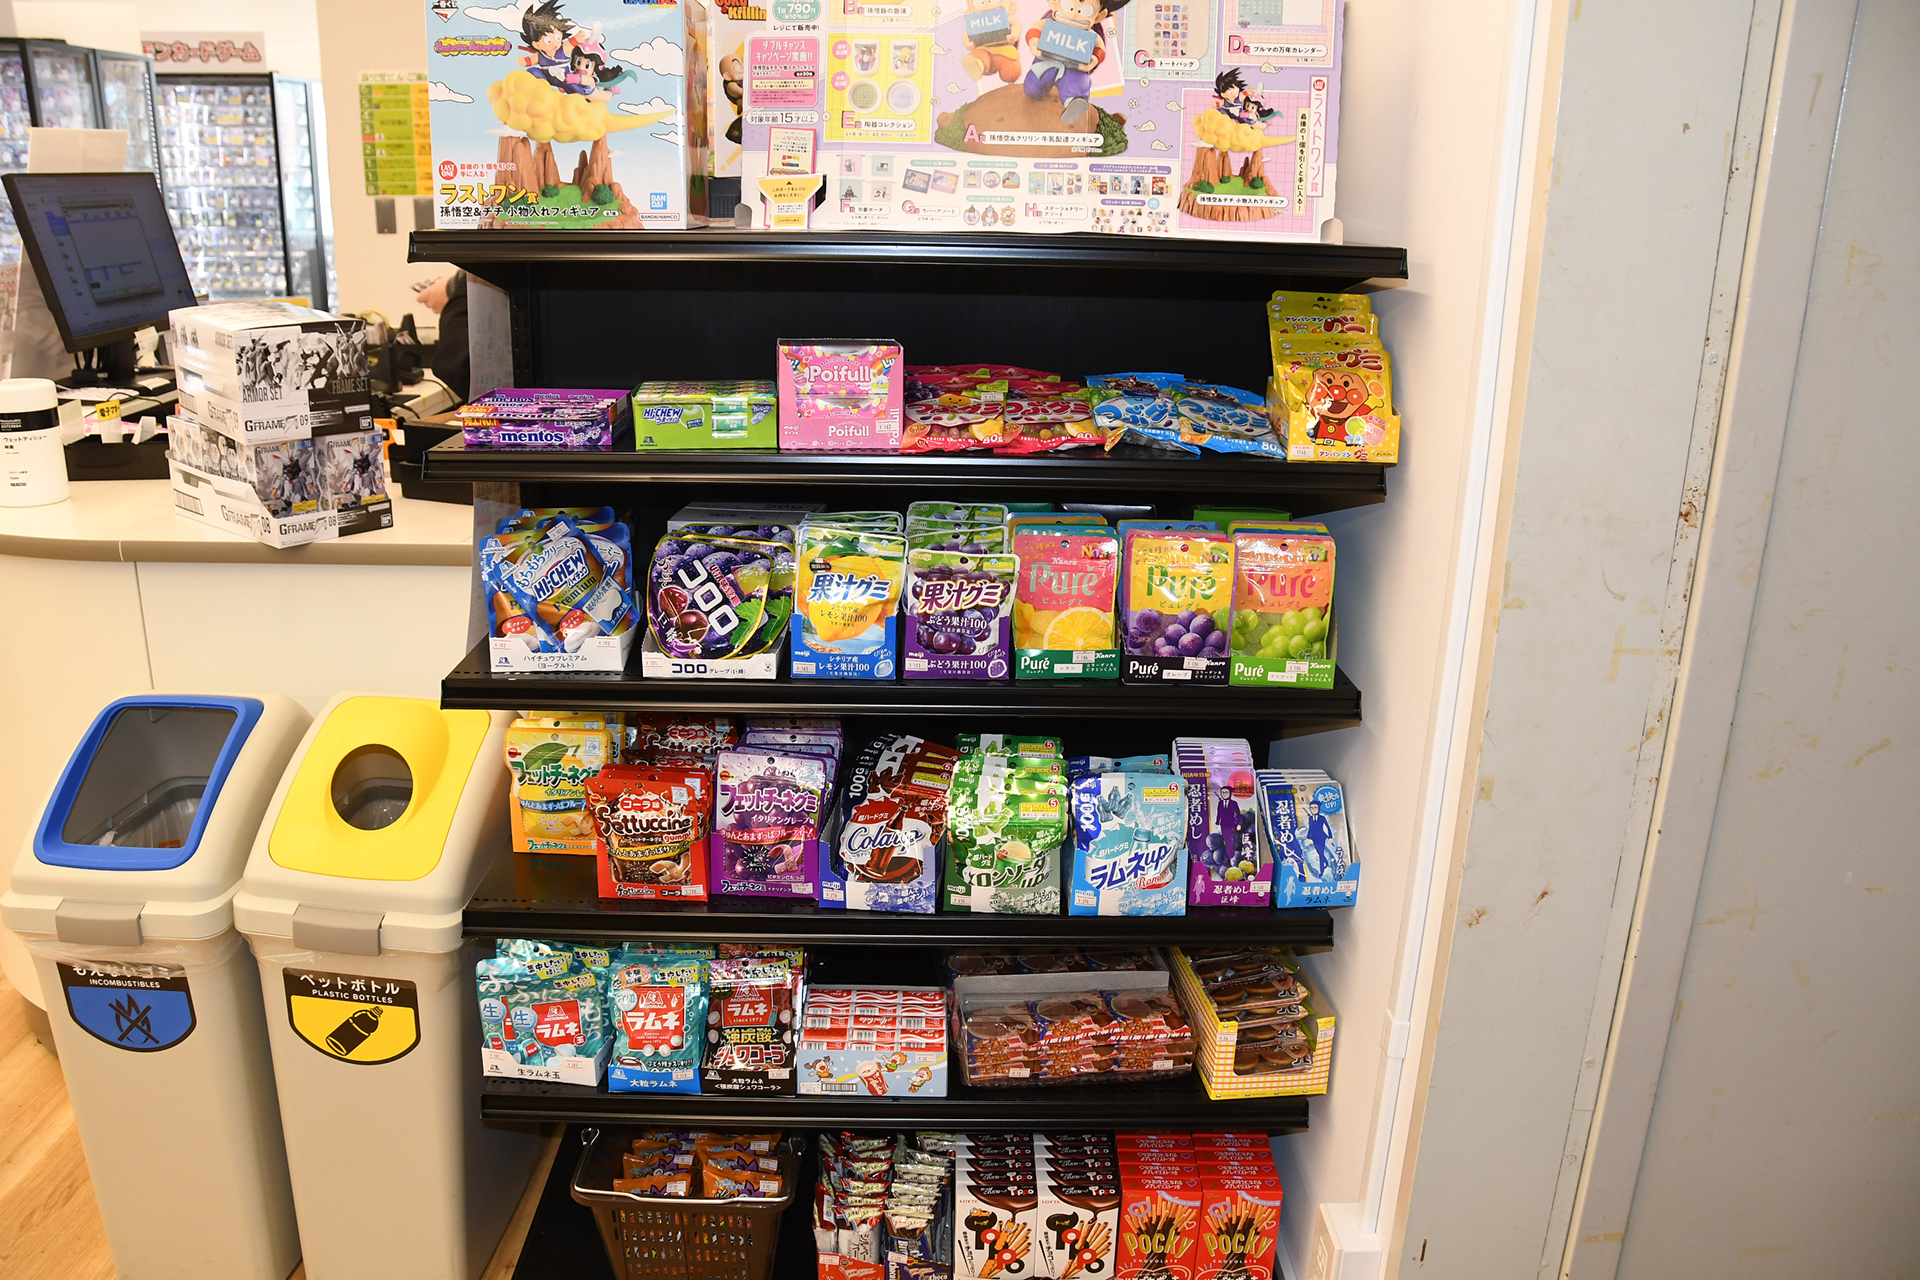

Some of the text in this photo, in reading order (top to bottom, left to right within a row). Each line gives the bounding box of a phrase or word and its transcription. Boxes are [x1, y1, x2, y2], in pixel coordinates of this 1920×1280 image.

[970, 14, 1002, 29] MILK
[763, 41, 806, 50] ダブルチャンス
[1046, 30, 1089, 53] MILK
[756, 52, 813, 62] キャンペーン実施!!
[1253, 46, 1323, 54] ブルマの万年カレンダー
[1159, 60, 1194, 68] トートバッグ
[990, 134, 1100, 143] 孫悟空&クリリン 牛乳配達フィギュア
[1311, 93, 1324, 193] ラストワン賞
[1296, 113, 1307, 211] 最後の1個を引くと手に入る!
[440, 170, 455, 178] ONE
[440, 183, 538, 205] ラストワン賞
[651, 194, 667, 202] BAN
[440, 206, 599, 218] 孫悟空&チチ 小物入れフィギュア
[1336, 349, 1383, 372] グミ
[809, 366, 871, 382] Poifull
[332, 377, 369, 394] FRAME SET
[242, 385, 283, 403] ARMOR SET
[643, 407, 683, 419] HI-CHEW
[906, 402, 1004, 416] つぶグミ
[1005, 401, 1092, 415] つぶグミ
[299, 415, 309, 426] 09
[500, 430, 565, 443] mentos
[828, 426, 870, 437] Poifull
[1354, 448, 1368, 460] グミ
[805, 532, 823, 540] meiji
[516, 540, 578, 588] もちもちクリーミー
[1052, 557, 1078, 565] Kanro
[531, 549, 586, 601] HI-CHEW
[566, 567, 590, 588] ハイチュウ
[1029, 562, 1098, 596] Puré
[808, 573, 892, 601] 果汁グミ
[1147, 565, 1216, 600] Puré
[553, 576, 597, 611] Premium
[678, 559, 739, 636] コロロ
[918, 581, 1003, 614] 果汁グミ
[1042, 597, 1083, 606] ピュレグミ
[1160, 601, 1200, 609] ピュレグミ
[561, 610, 581, 627] 生クリーム
[820, 610, 868, 622] レモン果汁100
[927, 615, 988, 630] ぶどう果汁100
[505, 620, 529, 630] 生クリーム
[671, 663, 708, 674] コロロ
[818, 662, 870, 672] レモン果汁100
[927, 660, 987, 669] ぶどう果汁100
[1020, 656, 1050, 670] Puré
[1129, 660, 1159, 674] Puré
[1234, 663, 1264, 677] Puré
[671, 729, 706, 738] コーラ味
[622, 799, 662, 811] コーラ味
[720, 784, 820, 816] フェットチーネグミ
[1325, 801, 1338, 809] UP!
[858, 812, 889, 822] 超ハードグミ
[1188, 783, 1203, 840] 忍者めし
[751, 815, 815, 825] イタリアングレープ味
[1275, 800, 1294, 857] 忍者めし
[527, 839, 569, 851] フェットチーネグミ
[1241, 832, 1254, 862] 巨峰
[972, 854, 993, 862] 超ハード
[1336, 847, 1347, 876] ラムネ
[1091, 846, 1172, 889] ラムネup
[1213, 884, 1250, 895] 忍者めし
[1301, 885, 1337, 895] 忍者めし
[1221, 896, 1240, 904] 巨峰
[1305, 896, 1331, 904] ラムネ
[574, 949, 608, 960] 集中したい
[527, 958, 565, 974] 集中したい
[89, 978, 161, 988] INCOMBUSTIBLES
[300, 974, 400, 995] ペットボトル
[554, 974, 593, 988] 集中したい
[312, 989, 393, 1003] PLASTIC BOTTLES
[483, 1003, 500, 1018] 生
[727, 1003, 768, 1016] ラムネ
[513, 1010, 532, 1026] 生
[627, 1012, 680, 1031] ラムネ
[536, 1022, 579, 1039] ラムネ
[726, 1028, 773, 1043] 強炭酸
[575, 1035, 586, 1045] 玉
[714, 1045, 785, 1065] シュワコーラ
[517, 1067, 560, 1079] 生ラムネ玉
[630, 1079, 678, 1087] 大粒ラムネ
[1006, 1146, 1030, 1155] Toppo
